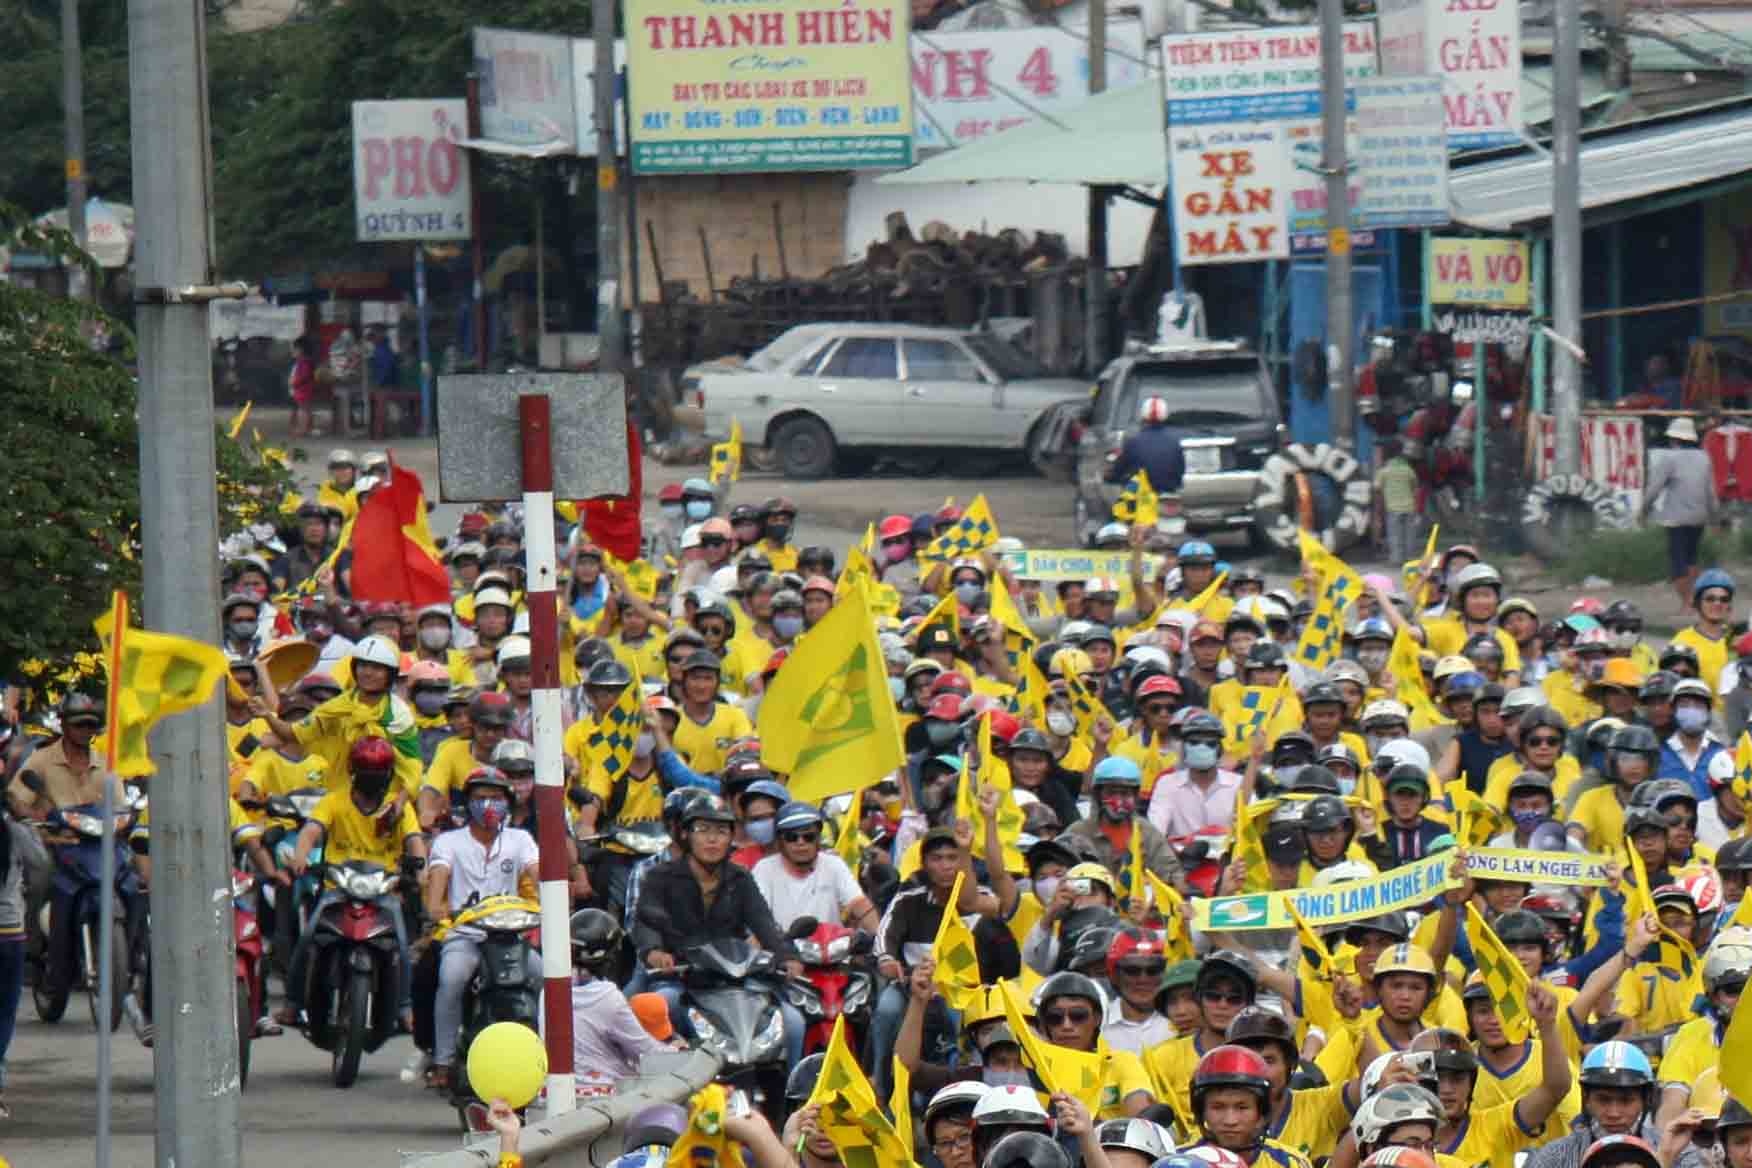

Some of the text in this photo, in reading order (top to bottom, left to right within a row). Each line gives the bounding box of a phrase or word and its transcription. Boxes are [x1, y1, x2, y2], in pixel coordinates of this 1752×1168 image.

[644, 12, 785, 49] THANH
[1440, 17, 1510, 72] GẮN
[1016, 47, 1056, 96] 4
[1441, 81, 1514, 128] MÁY
[1201, 150, 1255, 177] XE
[1184, 176, 1274, 217] GẮN
[455, 212, 465, 231] 4
[1186, 221, 1276, 256] MÁY
[1503, 858, 1535, 873] LAM
[1340, 882, 1376, 914] LAM
[1425, 861, 1446, 890] AN
[1642, 975, 1657, 1011] 7
